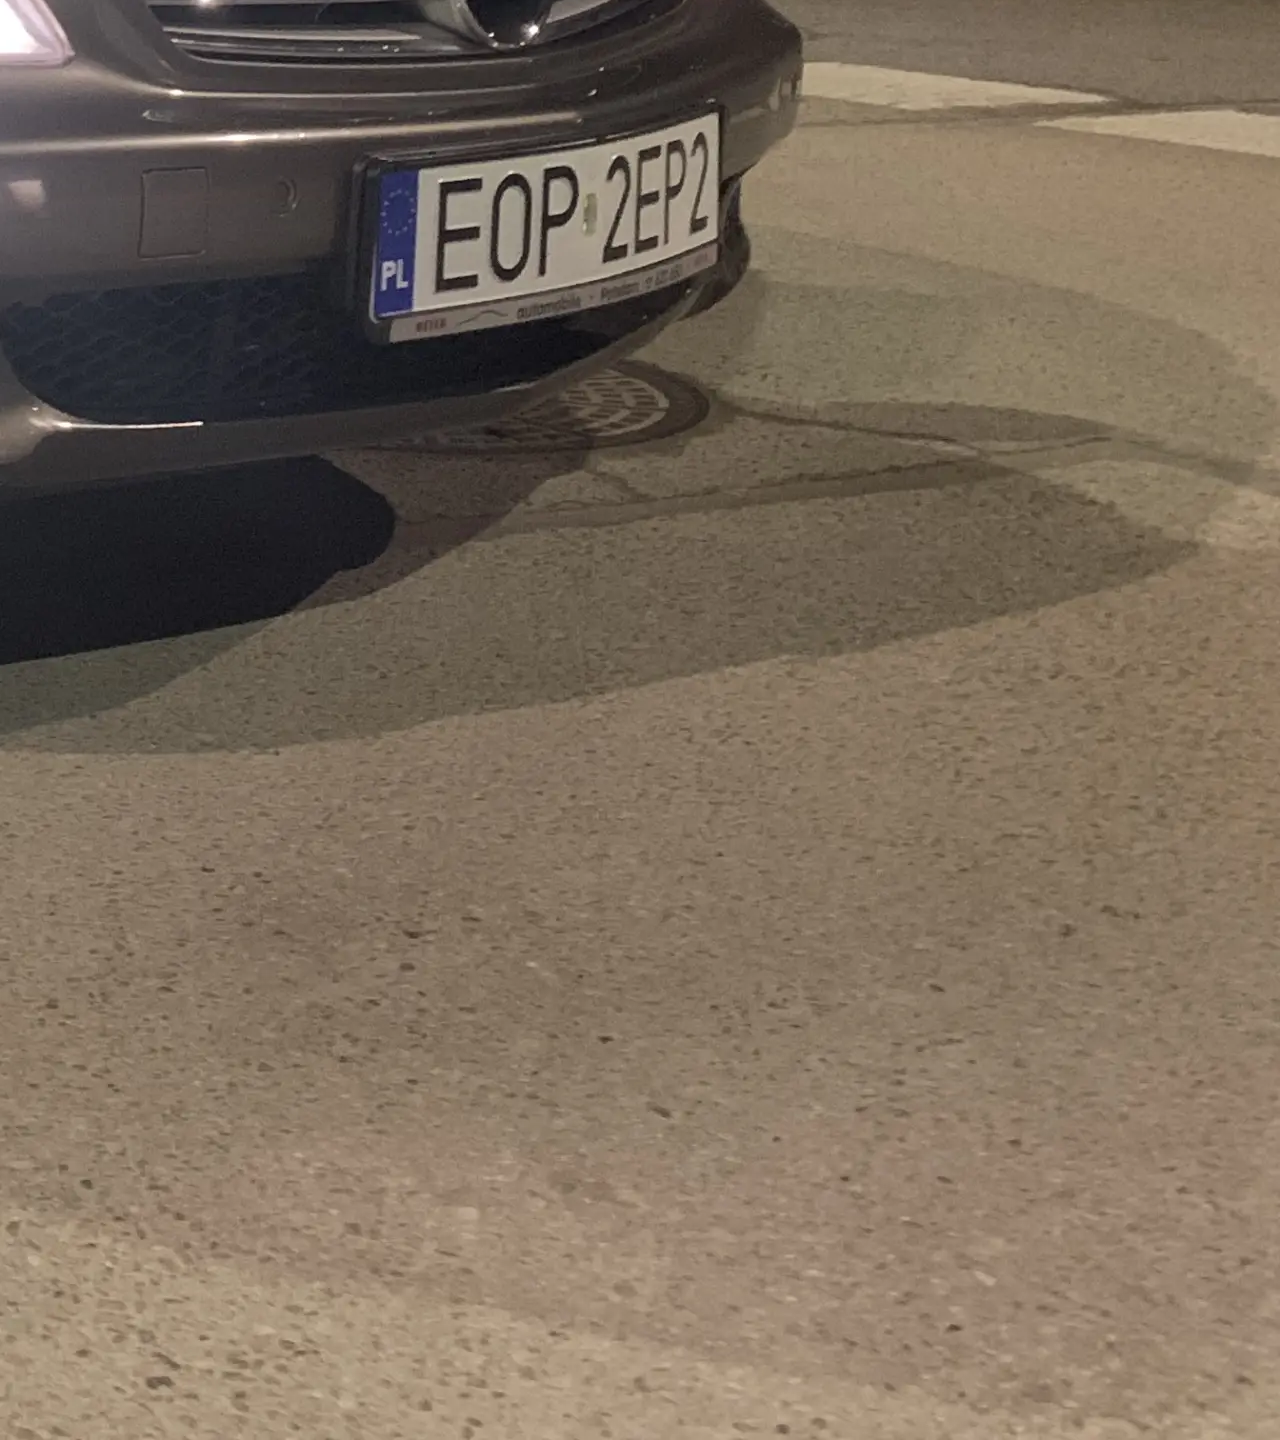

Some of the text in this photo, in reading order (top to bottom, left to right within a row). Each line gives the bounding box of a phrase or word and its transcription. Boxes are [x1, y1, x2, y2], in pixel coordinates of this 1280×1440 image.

[434, 131, 710, 294] EOP 2EP2
[380, 260, 409, 292] PL
